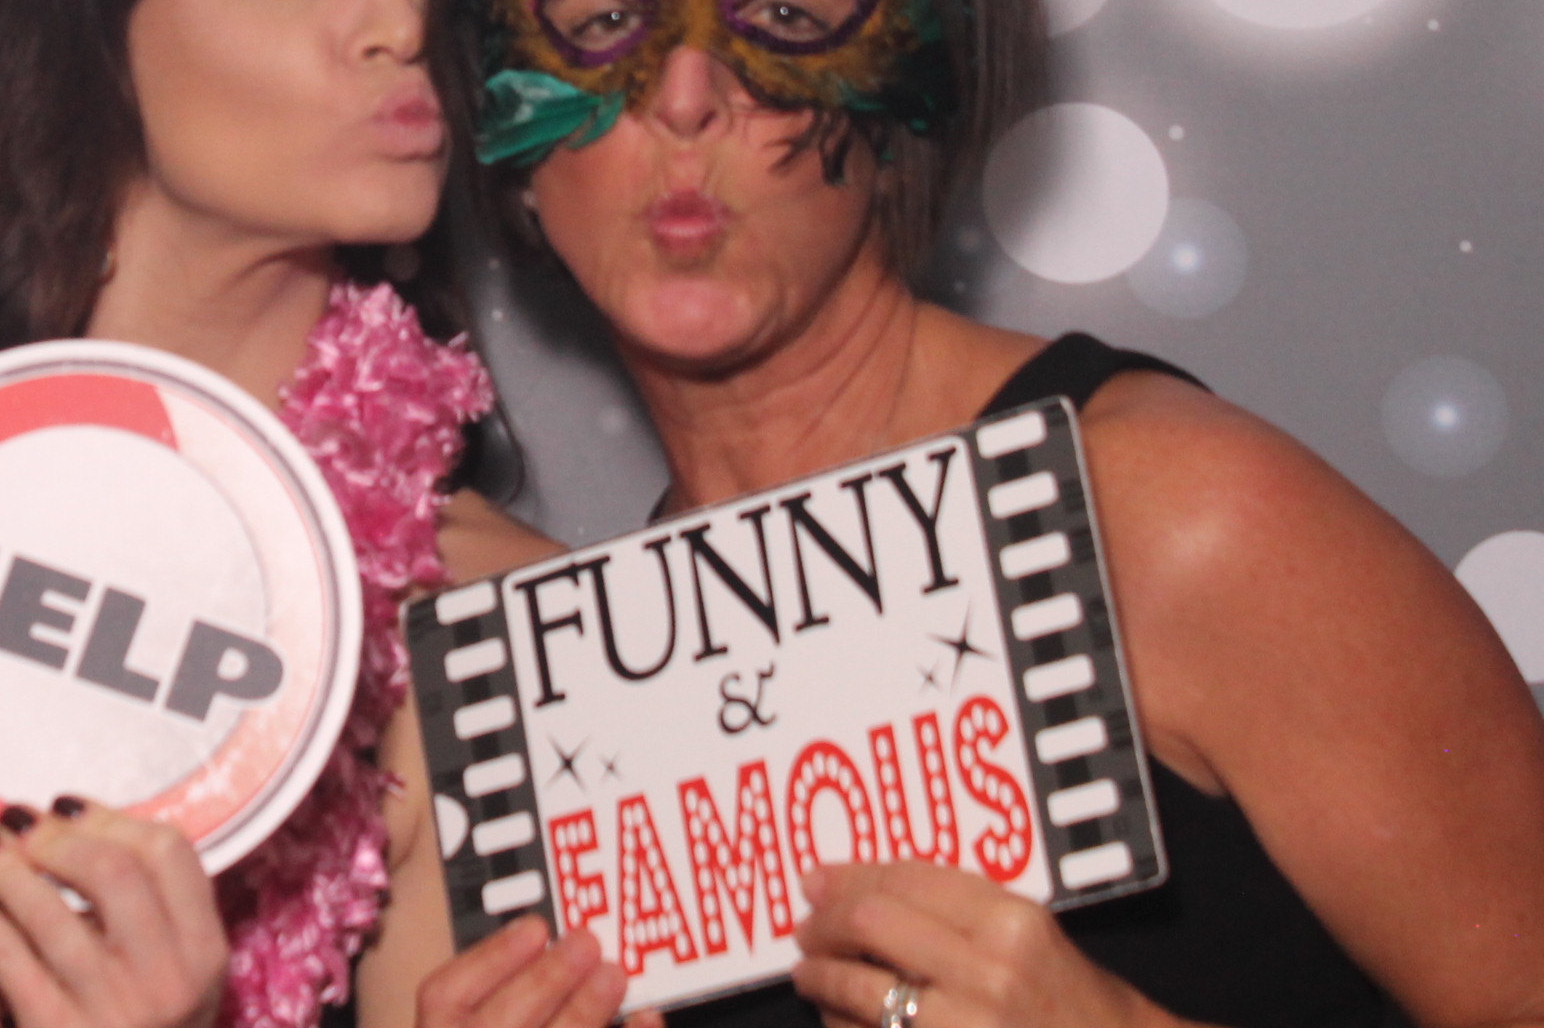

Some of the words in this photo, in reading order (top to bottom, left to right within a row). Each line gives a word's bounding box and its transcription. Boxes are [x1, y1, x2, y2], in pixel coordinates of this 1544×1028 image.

[513, 446, 959, 709] FUNNY
[717, 663, 777, 735] &
[548, 694, 1033, 976] FAMOUS
